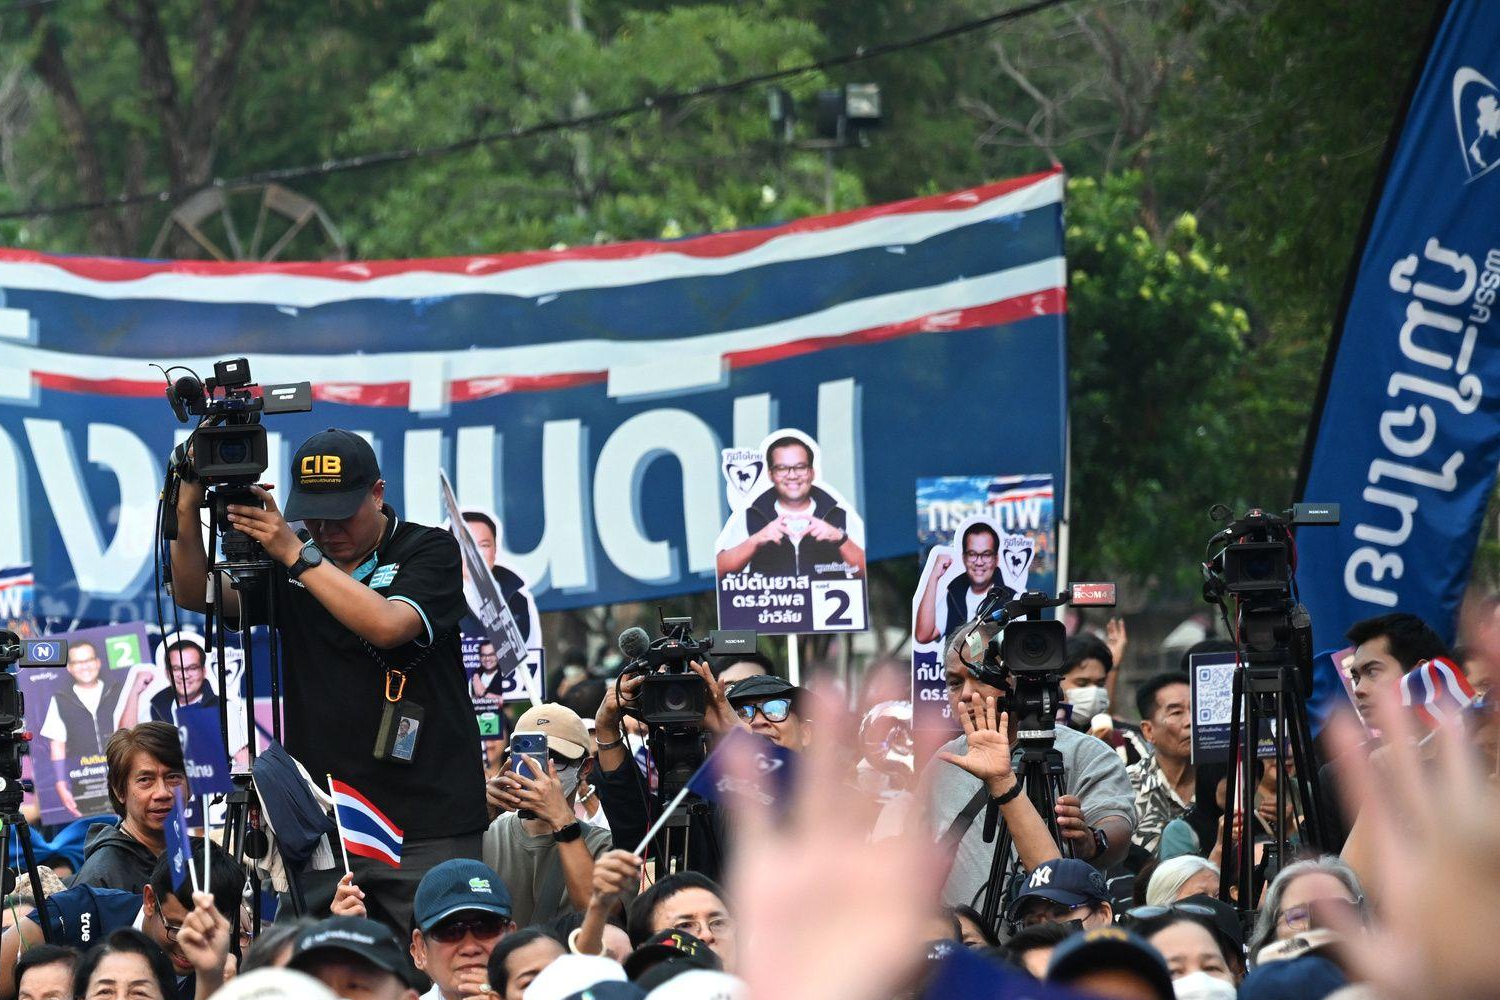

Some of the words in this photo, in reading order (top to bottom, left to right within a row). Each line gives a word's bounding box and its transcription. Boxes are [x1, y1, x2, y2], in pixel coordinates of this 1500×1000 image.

[1344, 236, 1484, 608] ภูมิใจไทย
[301, 455, 341, 475] CIB
[721, 573, 810, 591] กัปตันยาส
[732, 590, 805, 607] ดร.อำพล
[824, 589, 853, 626] 2
[758, 609, 803, 624] ขำวิลัย
[113, 641, 135, 668] 2
[80, 911, 91, 942] true
